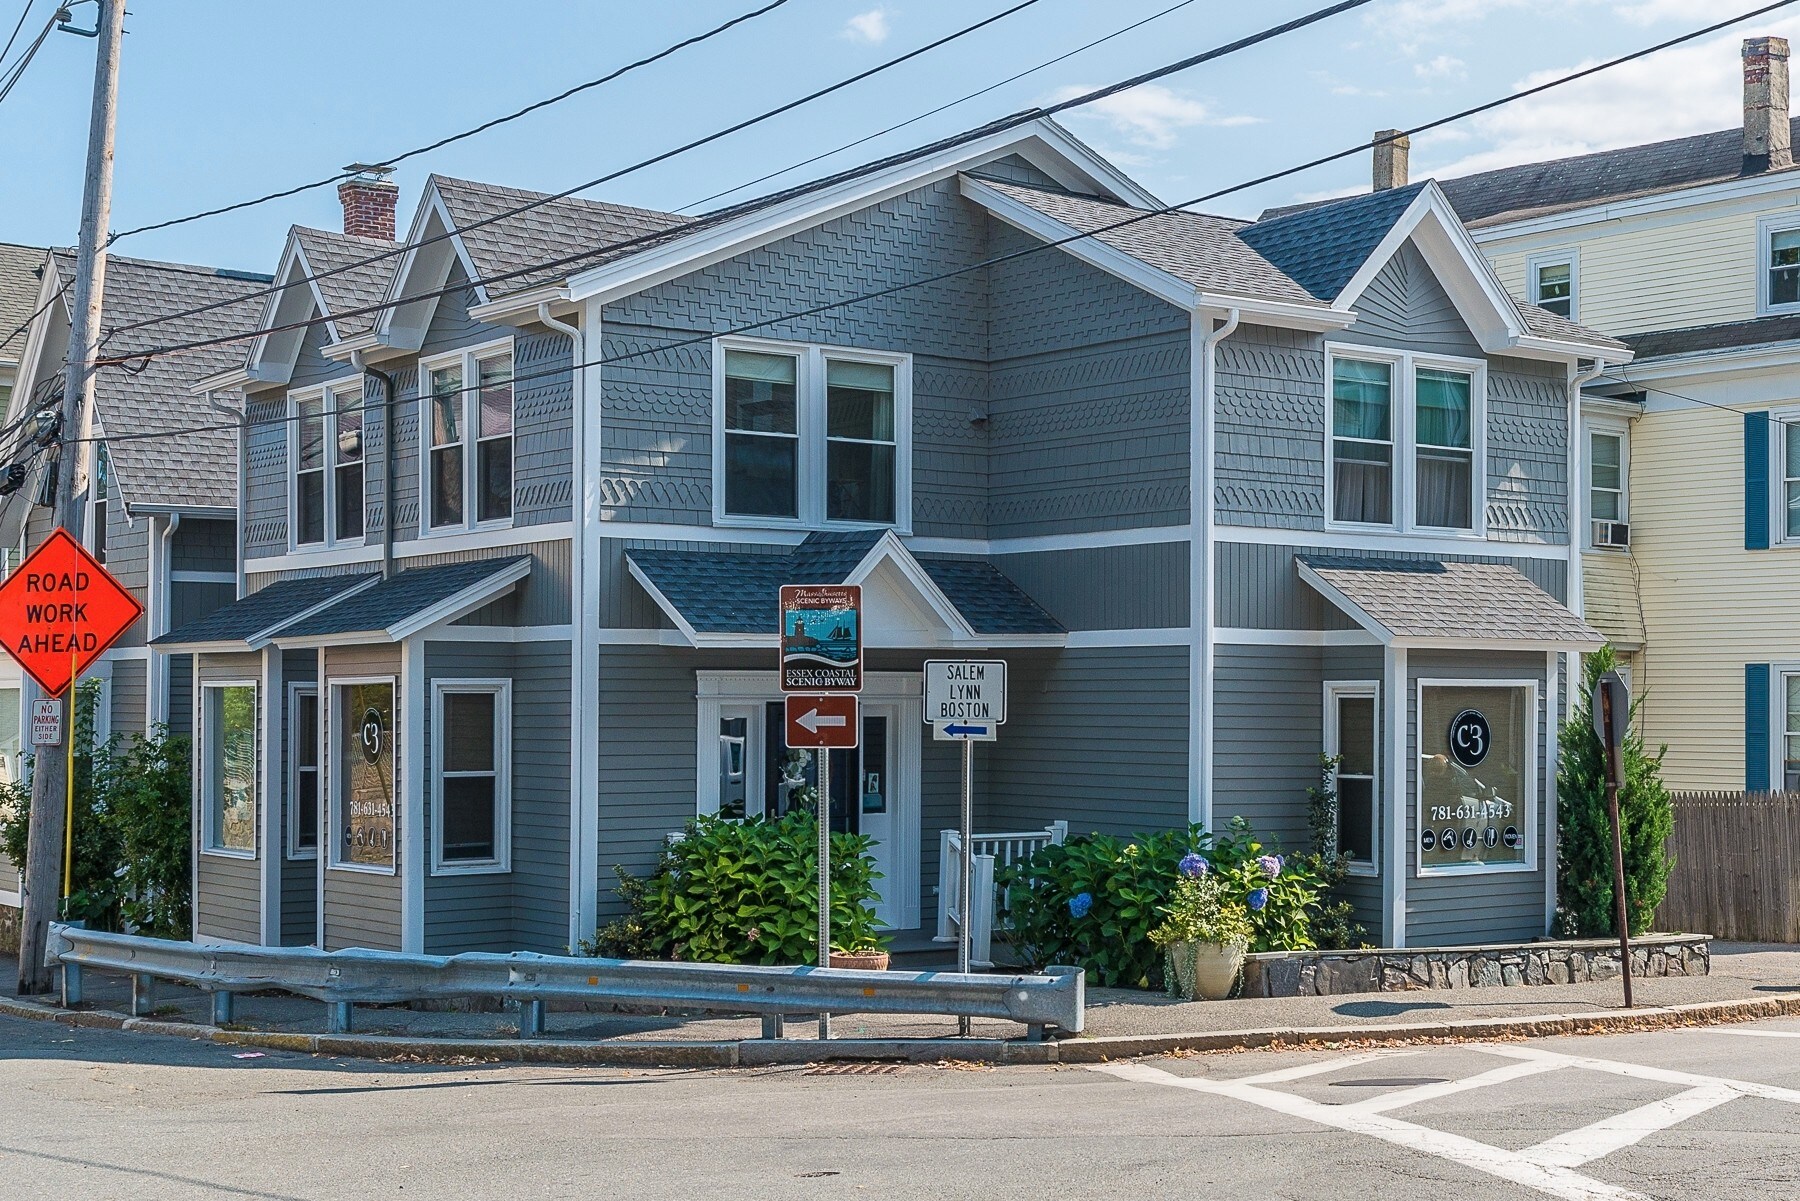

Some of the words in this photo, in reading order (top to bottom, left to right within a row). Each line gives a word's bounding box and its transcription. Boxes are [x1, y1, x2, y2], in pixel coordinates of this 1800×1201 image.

[27, 572, 89, 592] ROAD
[27, 603, 88, 623] WORK
[17, 633, 97, 653] AHEAD
[786, 669, 813, 678] ESSEX
[815, 669, 857, 678] COASTAL
[947, 665, 985, 680] SALEM
[786, 678, 823, 686] SCENIC
[824, 678, 857, 686] BYWAY
[950, 684, 981, 699] LYNN
[41, 704, 53, 714] NO
[941, 702, 989, 718] BOSTON
[33, 715, 59, 724] PARKING
[1431, 804, 1510, 820] 781-631-4543
